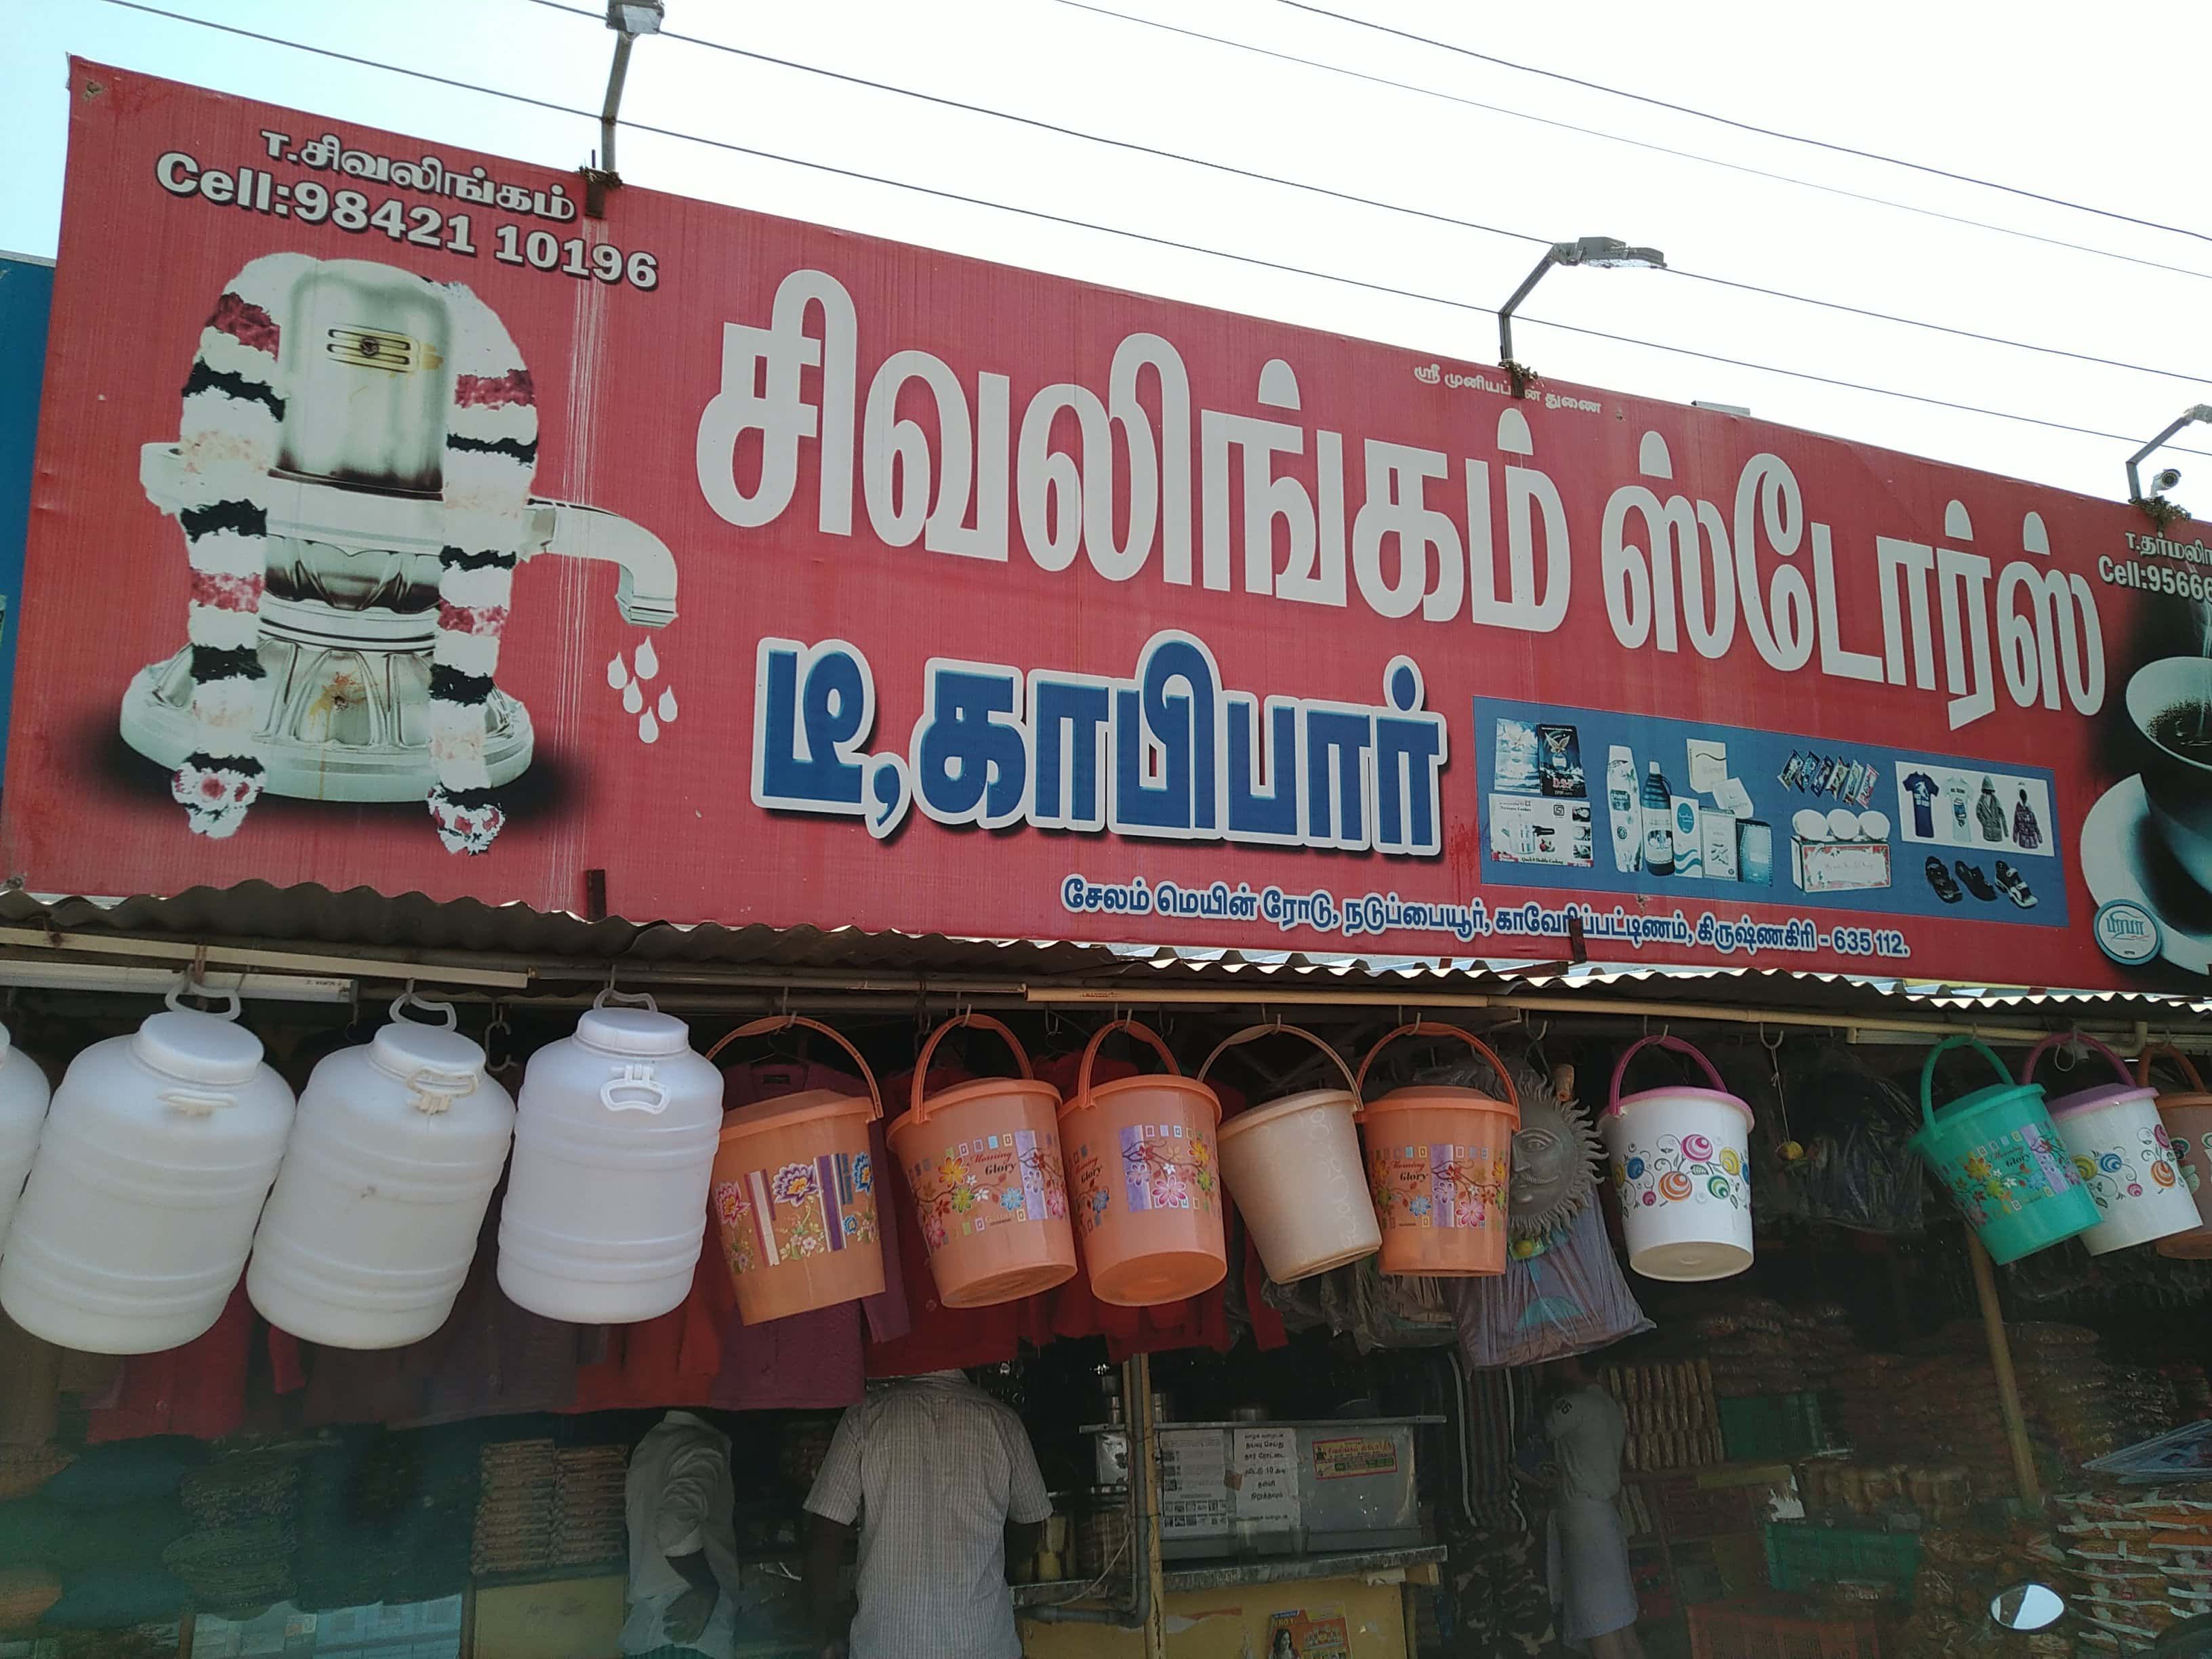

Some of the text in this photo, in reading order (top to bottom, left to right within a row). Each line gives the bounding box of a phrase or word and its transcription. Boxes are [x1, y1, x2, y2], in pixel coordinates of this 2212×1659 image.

[156, 151, 659, 291] Cell:98421 10196
[1444, 374, 1541, 401] முனியப்ன்
[696, 269, 2106, 731] சிவலிங்கம் ஸ்டோர்ஸ்
[1063, 876, 1151, 913] சேலம்
[1155, 882, 1258, 918] மெயின்
[1261, 887, 1339, 930] ரோடு,
[1833, 928, 1872, 951] 635
[985, 1163, 1017, 1176] Glory
[1399, 1171, 1429, 1183] Glory
